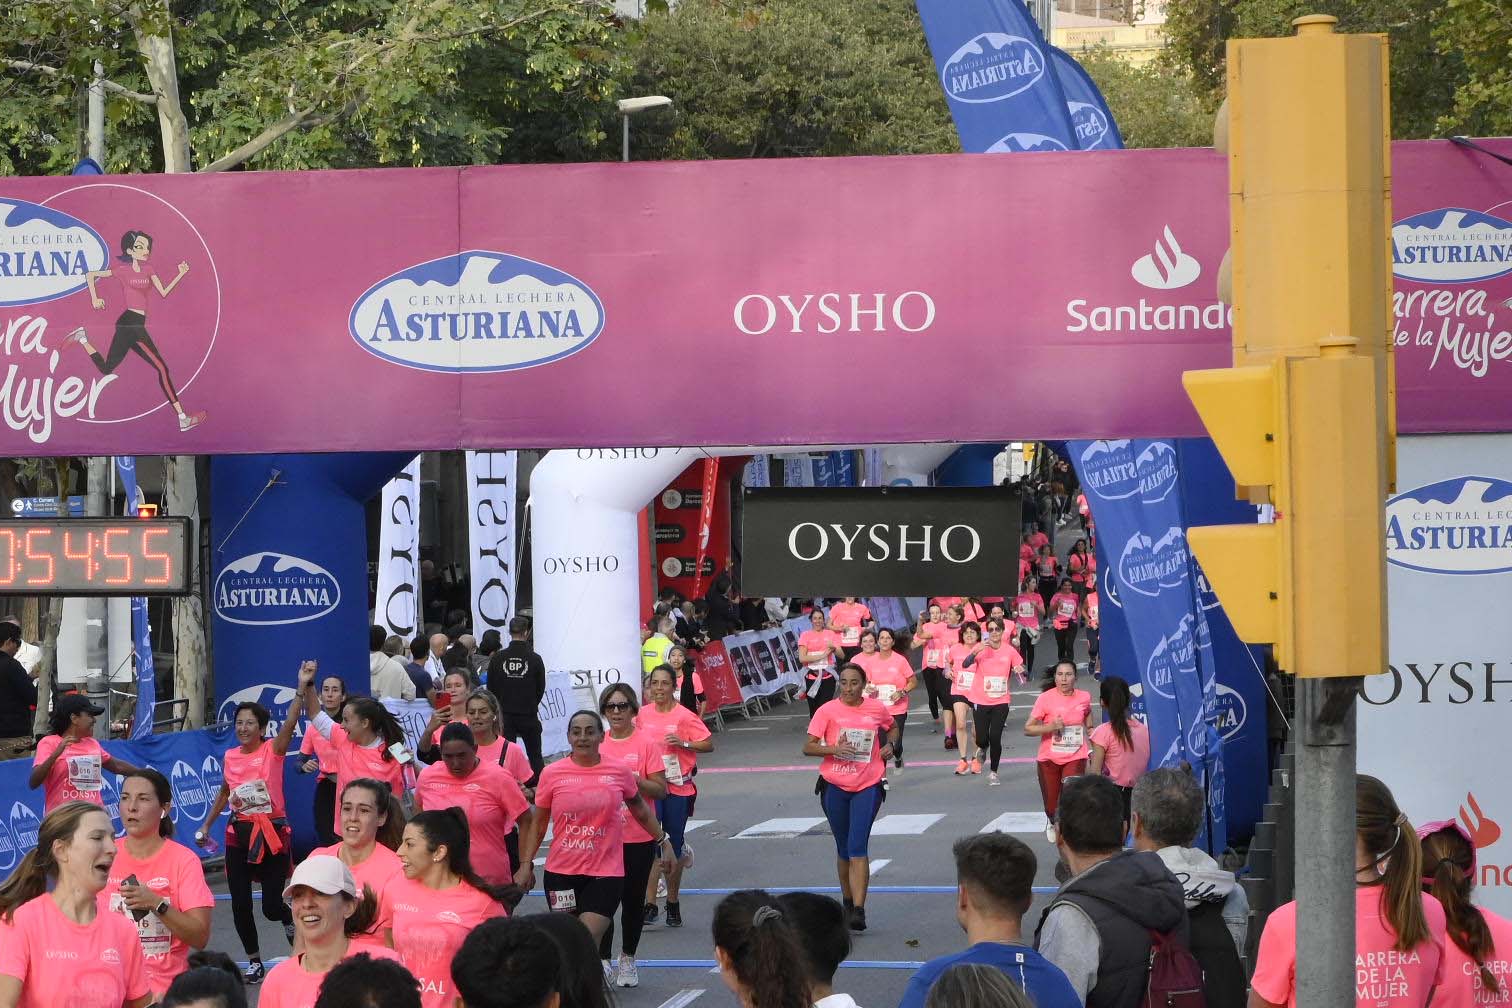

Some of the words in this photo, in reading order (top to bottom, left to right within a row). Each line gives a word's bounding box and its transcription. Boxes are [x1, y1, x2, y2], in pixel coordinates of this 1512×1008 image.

[12, 235, 84, 245] LECHERA
[1406, 234, 1458, 242] CENTRAL
[408, 293, 488, 307] CENTRAL
[495, 291, 577, 304] LECHERA
[1393, 289, 1488, 319] arrera
[369, 298, 585, 343] ASTURIANA
[733, 290, 937, 335] OYSHO
[1416, 319, 1434, 346] la
[1429, 316, 1512, 378] Muje
[1412, 510, 1480, 521] CENTRAL
[788, 522, 981, 563] OYSHO
[543, 555, 619, 575] OYSHO
[230, 577, 273, 587] CENTRAL
[278, 576, 327, 586] LECHERA
[218, 582, 331, 609] ASTURIANA
[509, 662, 523, 671] BP
[1358, 661, 1512, 706] OYSH
[558, 893, 575, 902] 016
[1356, 950, 1421, 967] ARRERA
[1357, 968, 1379, 985] DE
[1385, 967, 1406, 982] LA
[1356, 982, 1409, 1001] MUJER
